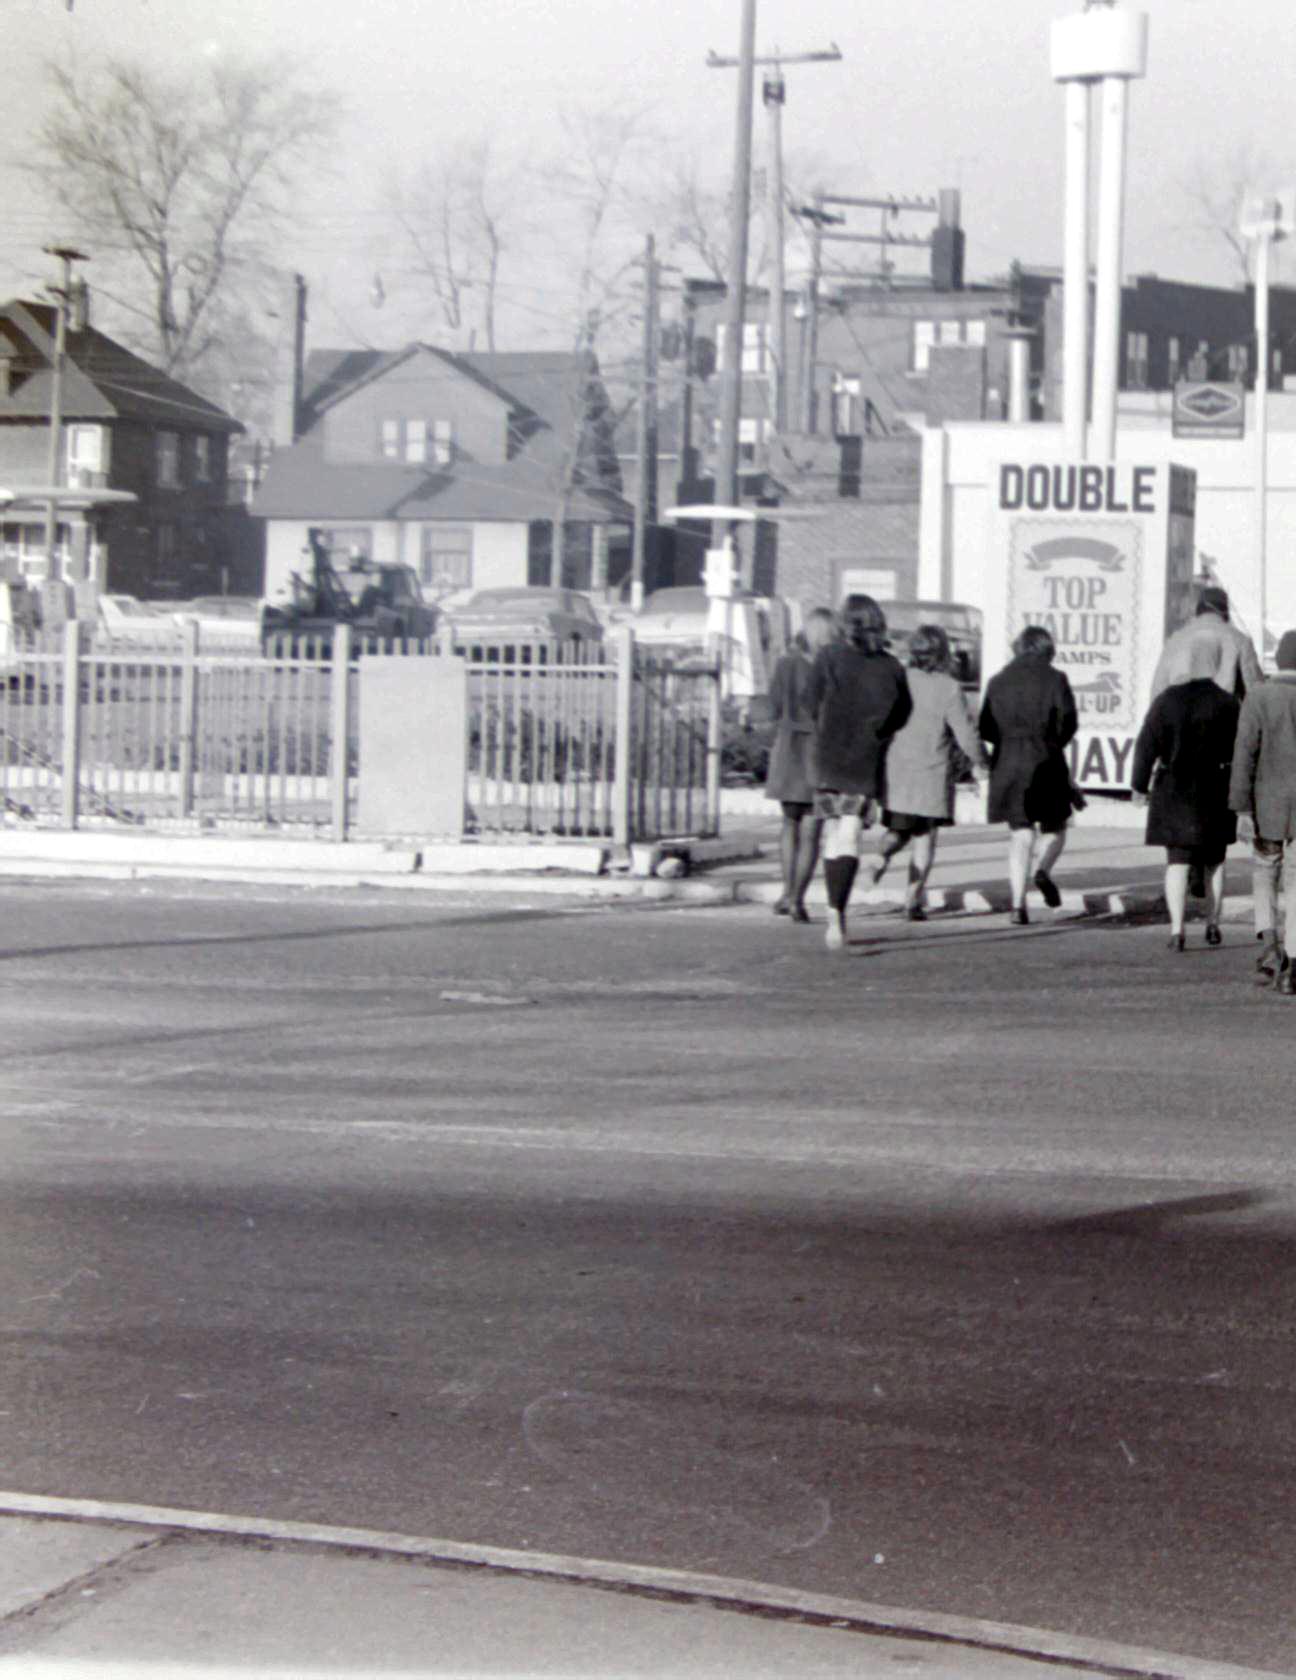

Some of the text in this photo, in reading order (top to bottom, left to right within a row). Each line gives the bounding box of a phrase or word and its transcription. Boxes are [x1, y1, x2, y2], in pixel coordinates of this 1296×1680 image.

[999, 463, 1157, 513] DOUBLE
[1043, 575, 1107, 610] TOP
[1055, 650, 1112, 666] AMPS
